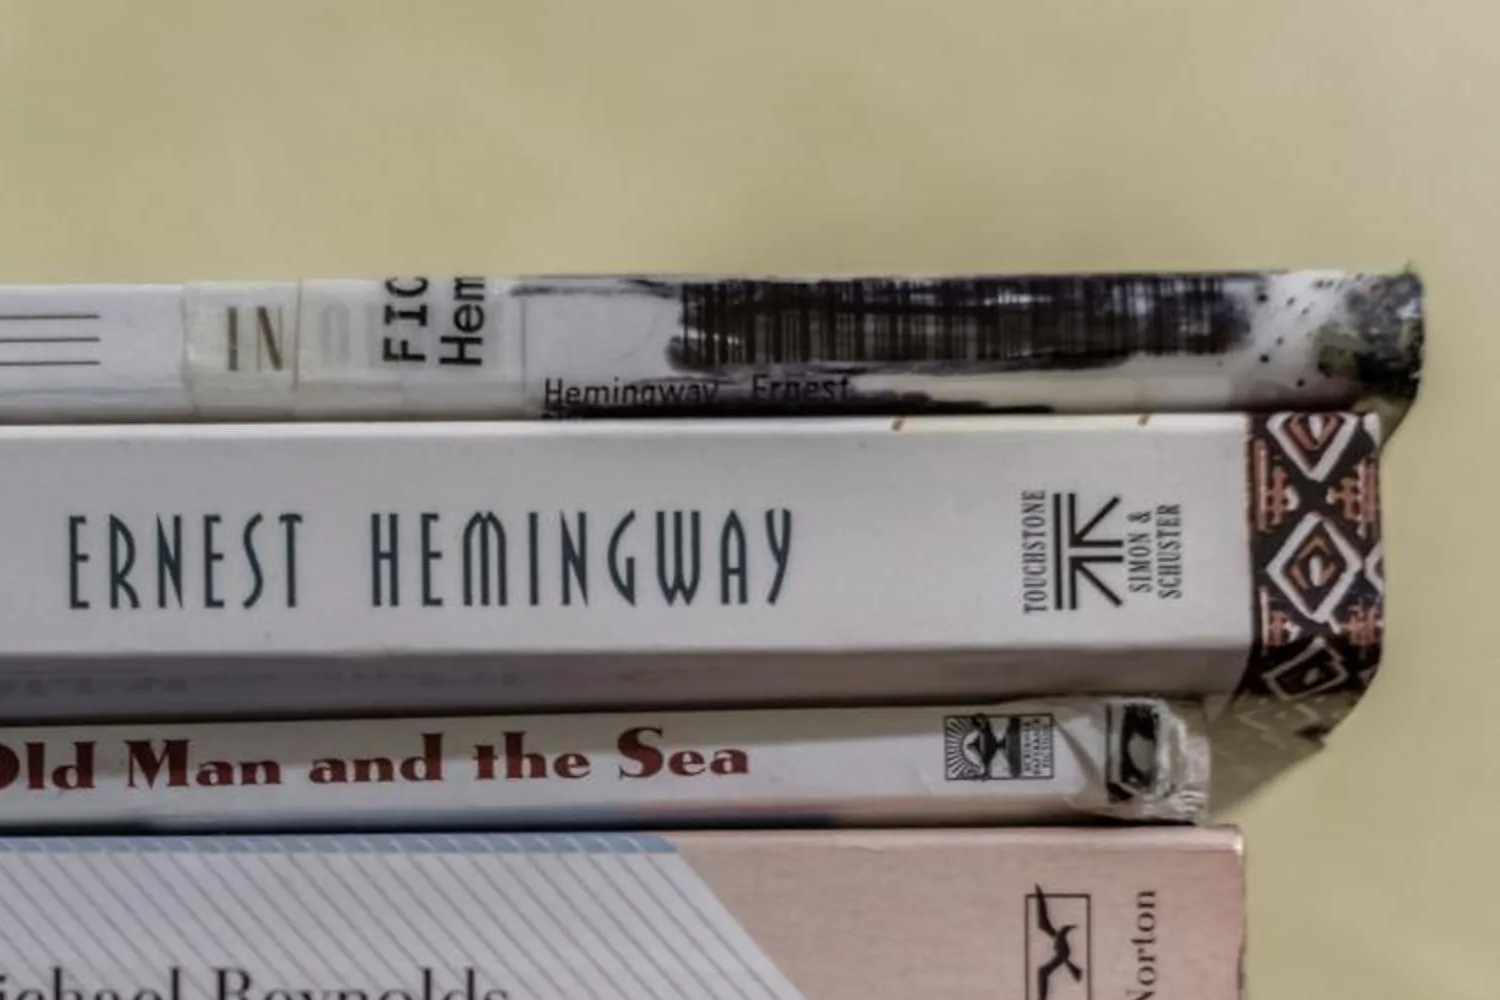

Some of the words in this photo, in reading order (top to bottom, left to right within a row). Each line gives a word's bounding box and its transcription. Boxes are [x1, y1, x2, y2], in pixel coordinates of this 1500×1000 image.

[227, 305, 283, 372] IN
[382, 277, 429, 362] FIC
[1021, 490, 1048, 615] TOUCHSTONE
[1127, 510, 1152, 524] &
[1156, 504, 1182, 599] SCHUSTER
[68, 513, 304, 610] ERNEST
[370, 508, 793, 609] HEMINGWAY
[1127, 533, 1153, 593] SIMON
[123, 738, 282, 787] Man
[309, 733, 445, 784] and
[474, 731, 591, 780] the
[617, 726, 750, 779] Sea
